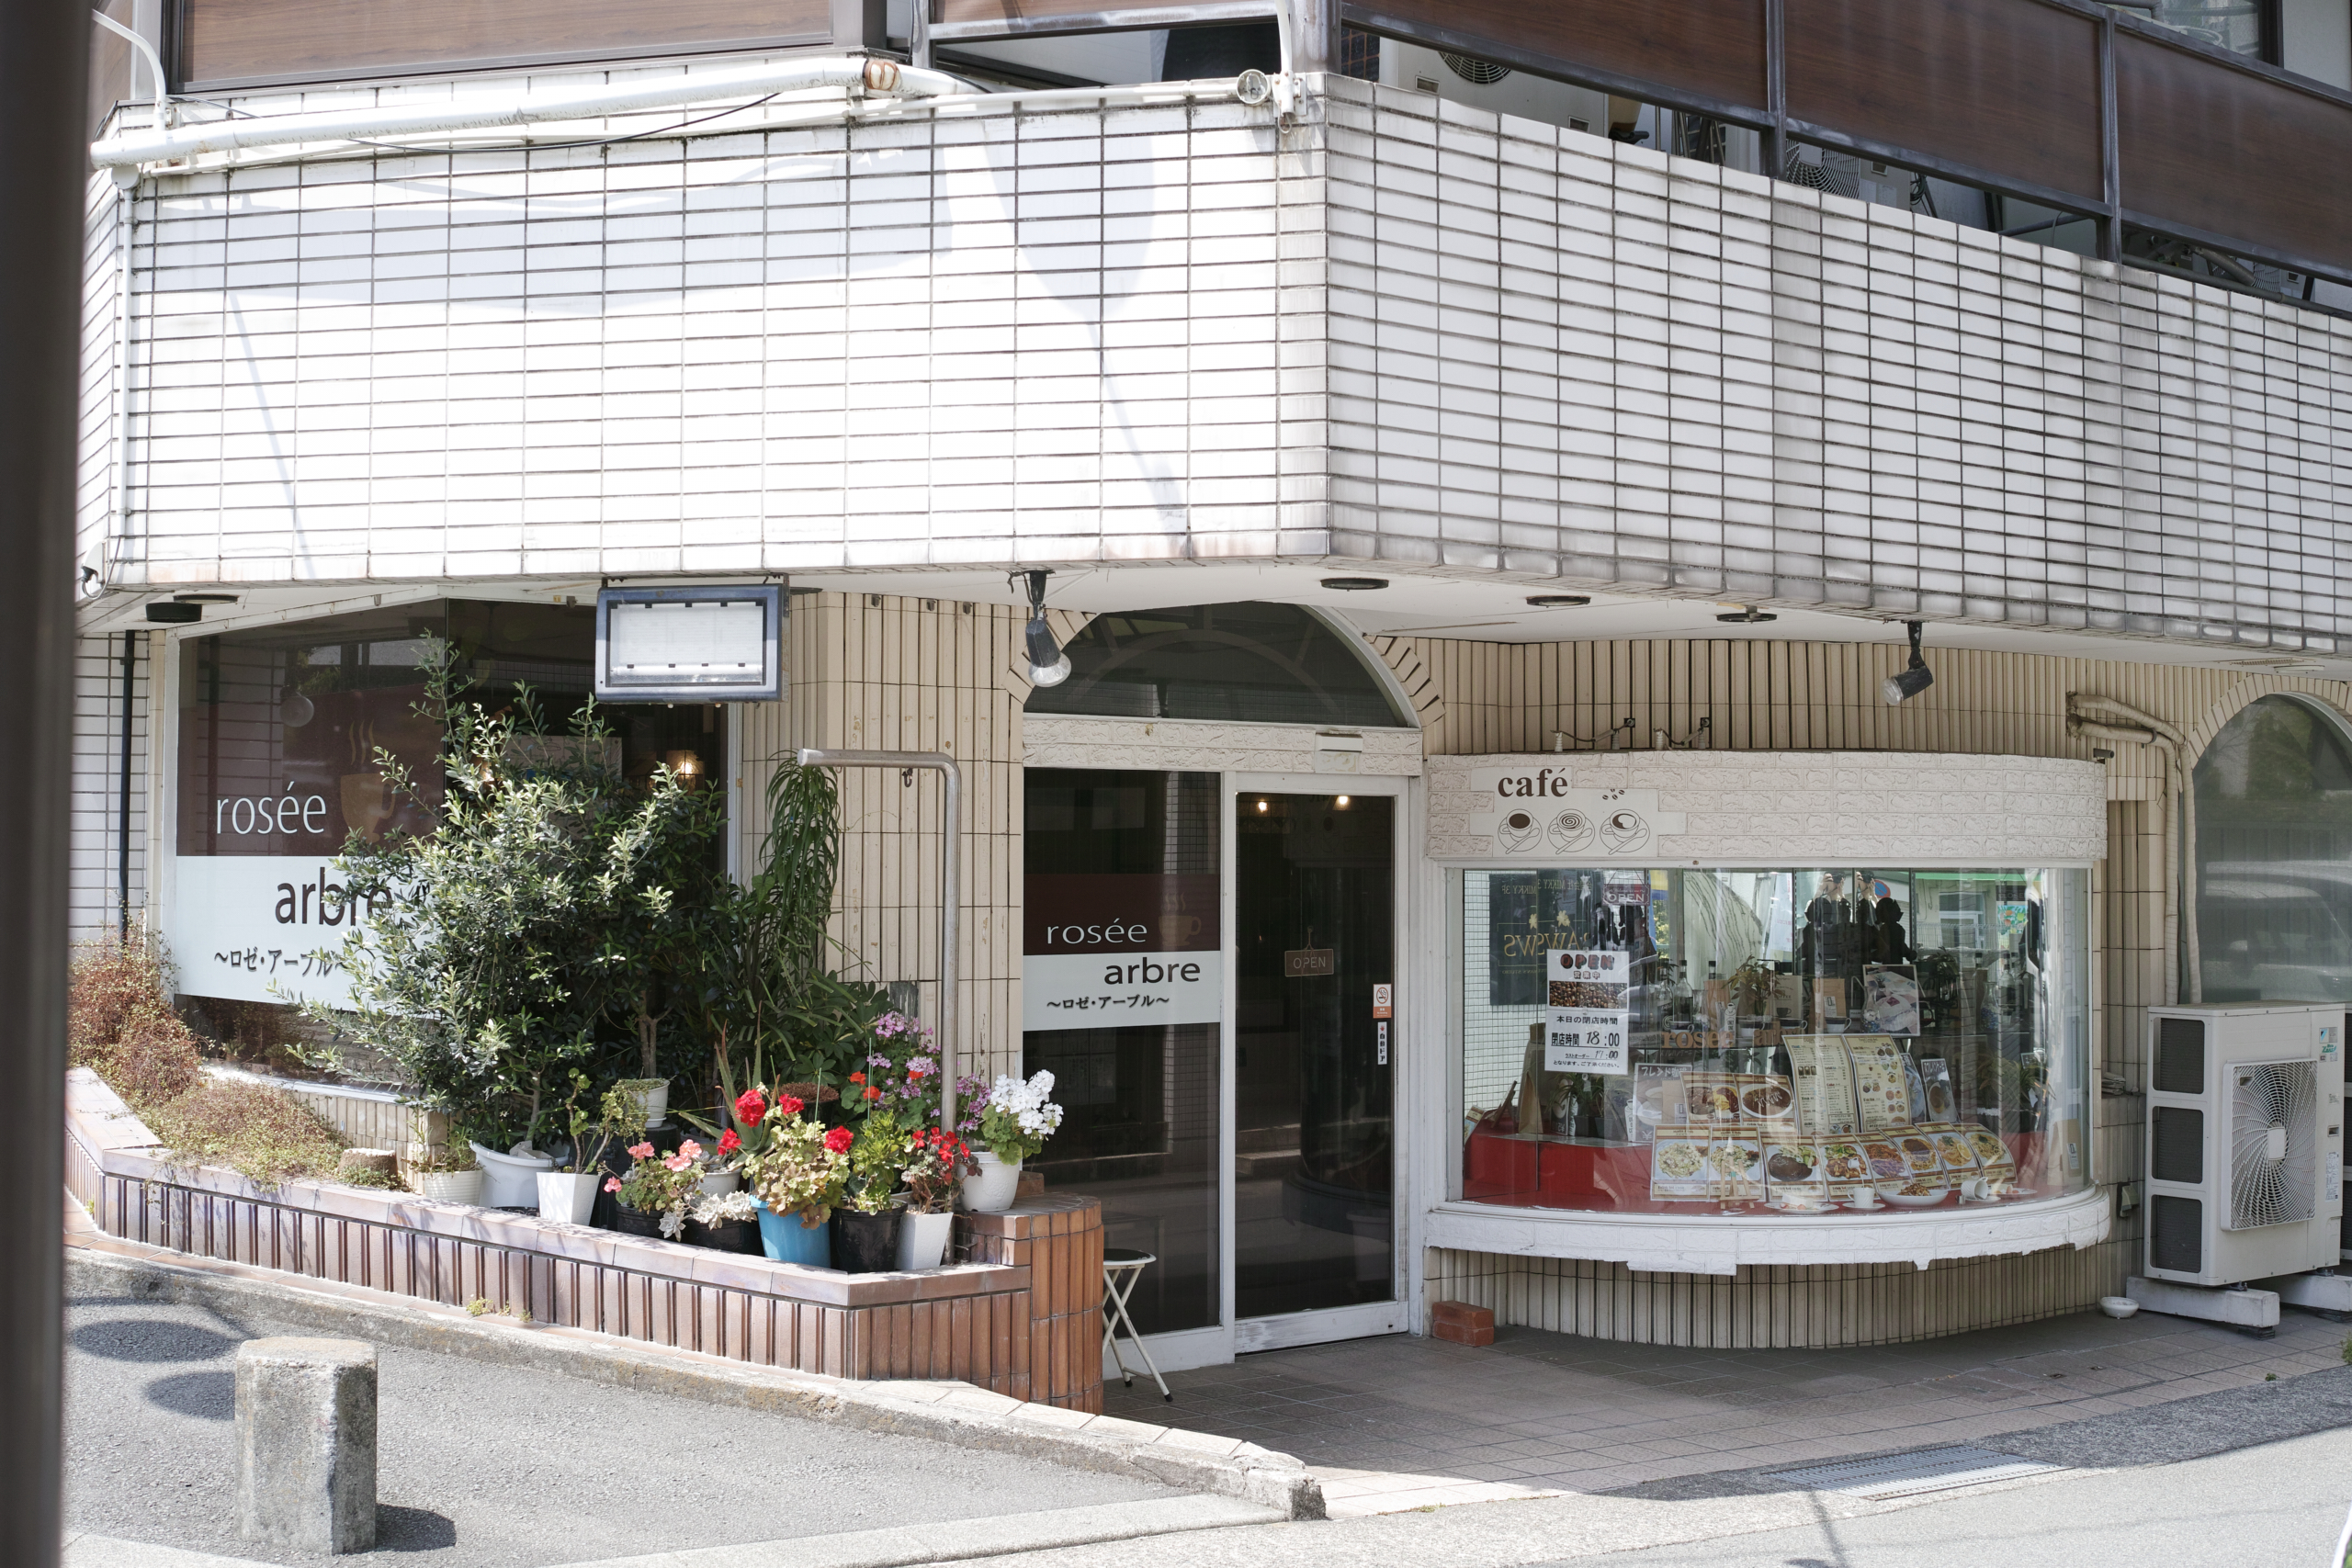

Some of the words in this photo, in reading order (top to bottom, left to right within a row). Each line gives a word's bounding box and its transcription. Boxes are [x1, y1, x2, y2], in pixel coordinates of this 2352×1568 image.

[1498, 767, 1568, 797] café
[216, 781, 326, 834] rosée
[1608, 894, 1645, 902] OPEN
[1046, 918, 1148, 944] rosée
[1293, 956, 1326, 969] OPEN
[1560, 953, 1614, 970] OPEN
[1104, 956, 1201, 985] arbre
[1573, 971, 1600, 980] 営業中
[1556, 1015, 1618, 1025] 本日の閉店時間
[1551, 1032, 1579, 1046] 閉店時間
